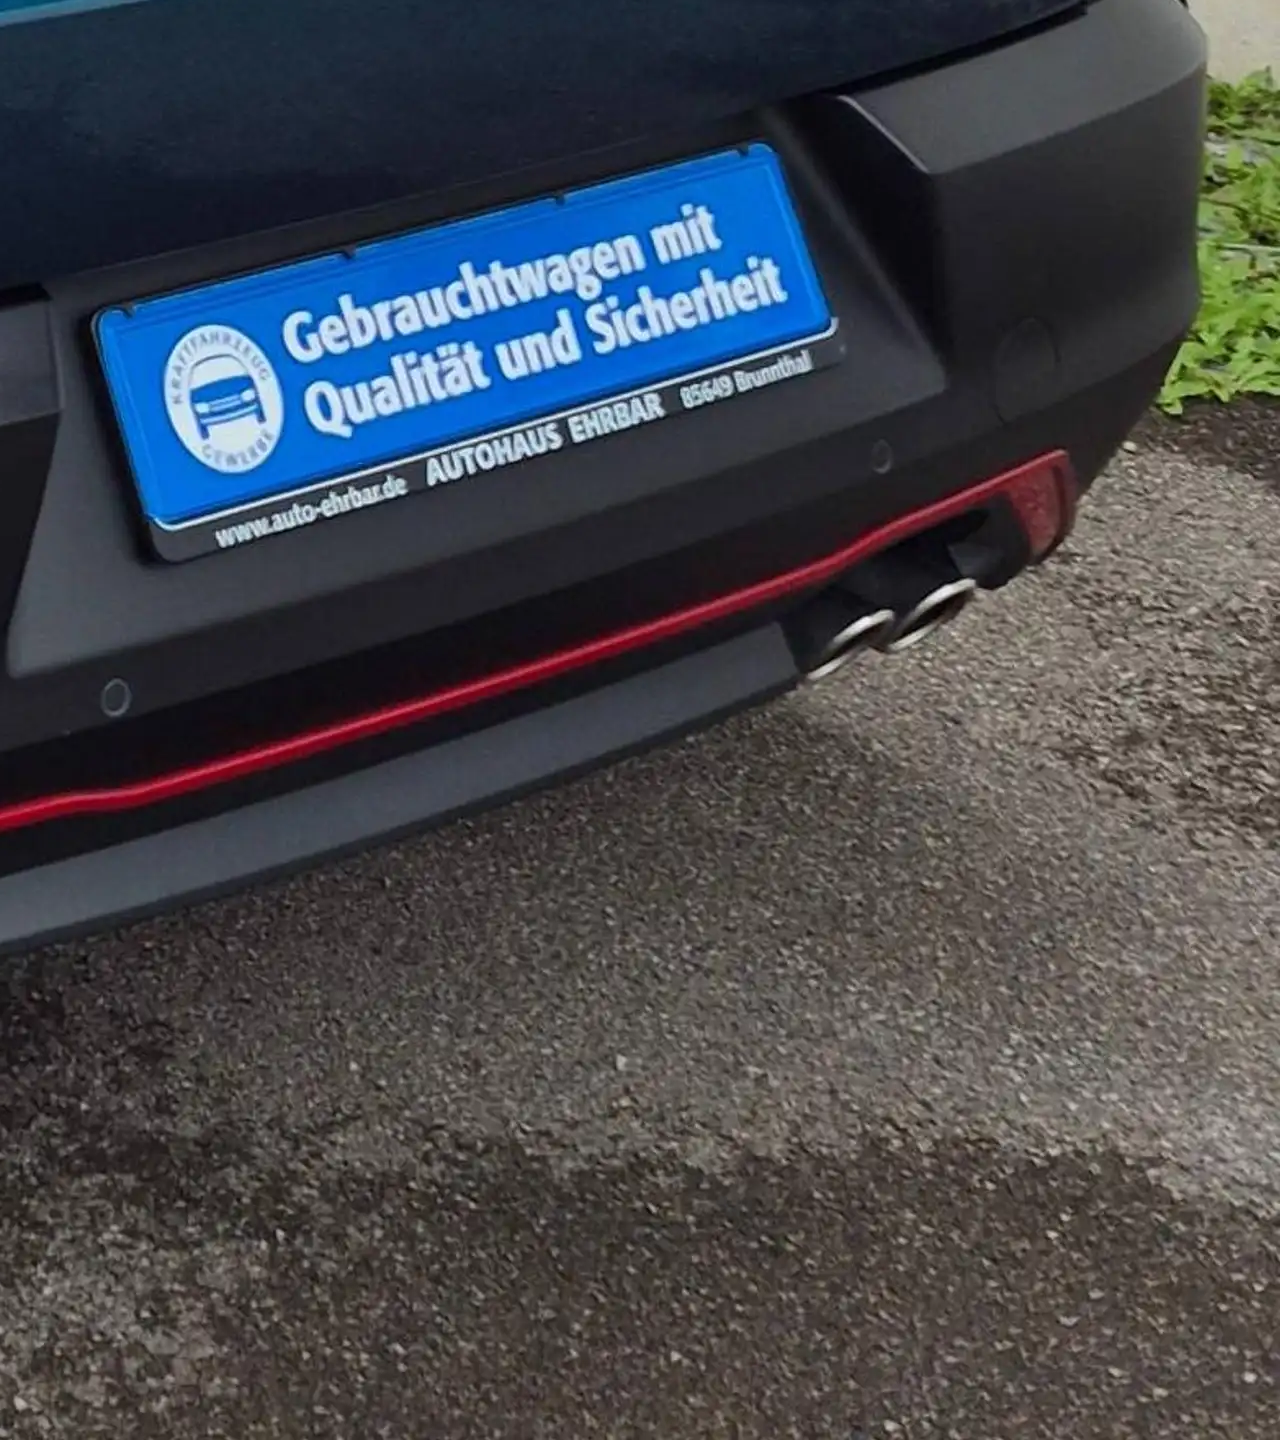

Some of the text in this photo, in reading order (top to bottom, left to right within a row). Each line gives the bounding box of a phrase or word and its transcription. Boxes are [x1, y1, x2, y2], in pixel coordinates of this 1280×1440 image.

[282, 203, 724, 363] Gebrauchtwagen mit
[304, 255, 789, 439] Qualität und Sicherheit
[215, 349, 814, 549] www.auto-ehrbar.de AUTOHAUS EHRBAR 85649 Brunnthal
